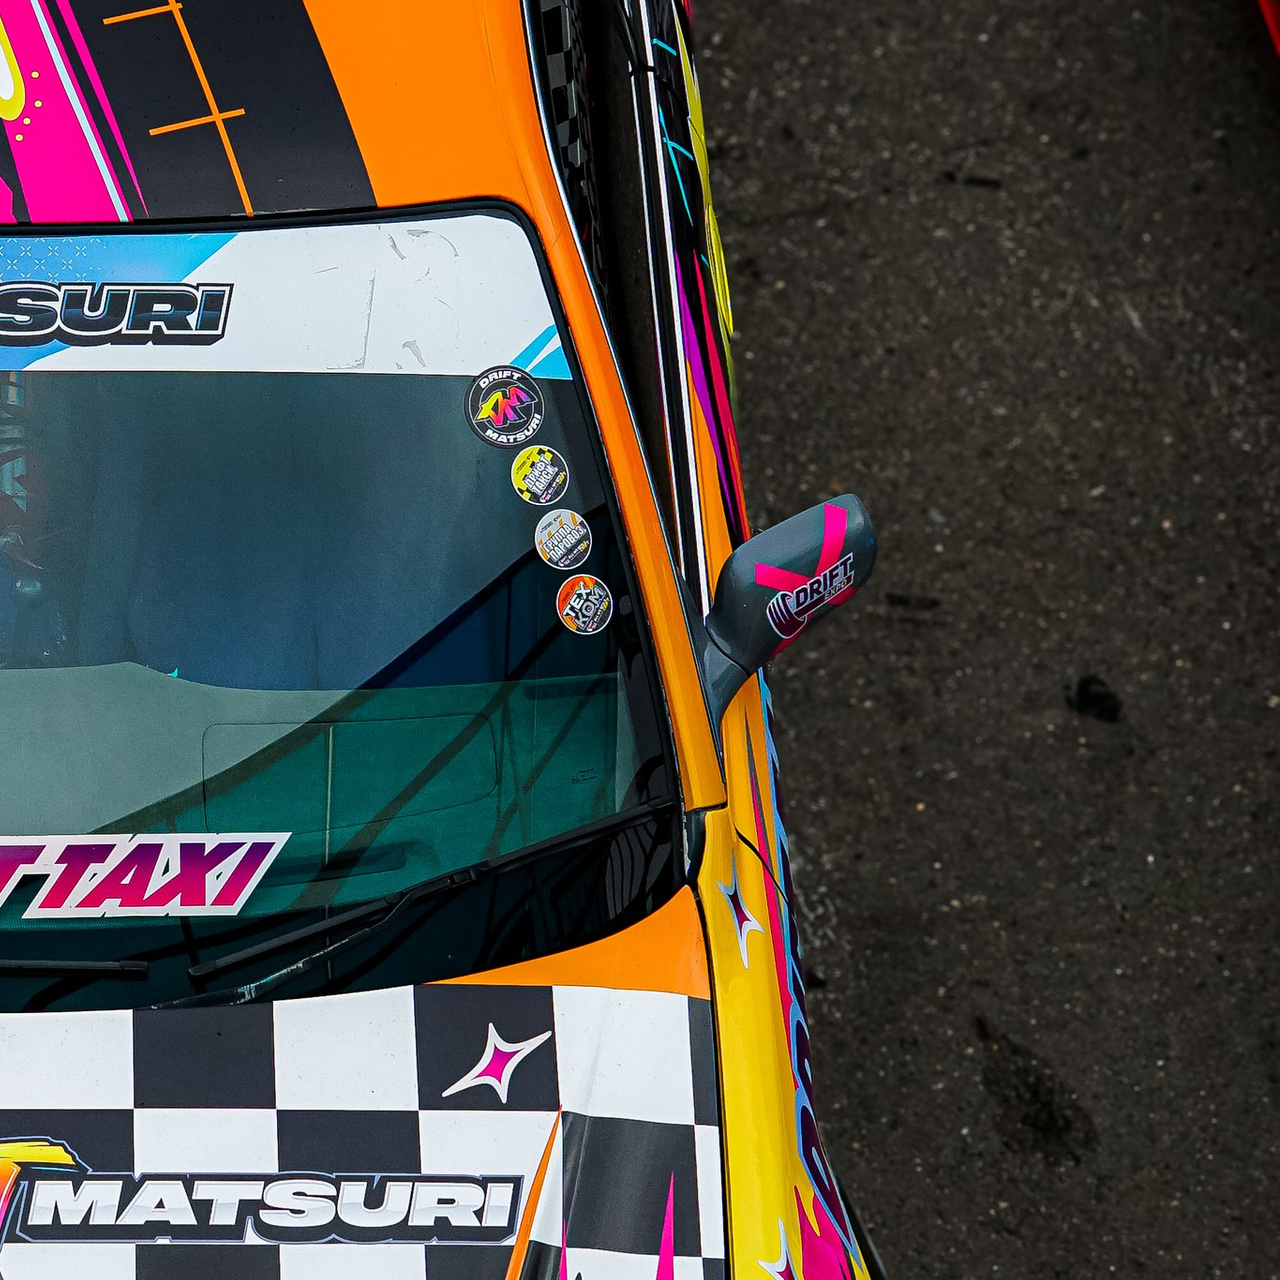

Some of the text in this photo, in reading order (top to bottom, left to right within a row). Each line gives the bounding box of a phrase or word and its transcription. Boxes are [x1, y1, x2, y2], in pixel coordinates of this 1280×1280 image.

[479, 370, 521, 389] DRIFT
[485, 413, 542, 443] MATSURI
[542, 524, 572, 553] ГРУППА
[792, 552, 854, 610] DRIFT
[823, 579, 849, 601] EXPO
[37, 840, 280, 910] TAXI
[22, 1175, 516, 1233] MATSURI
